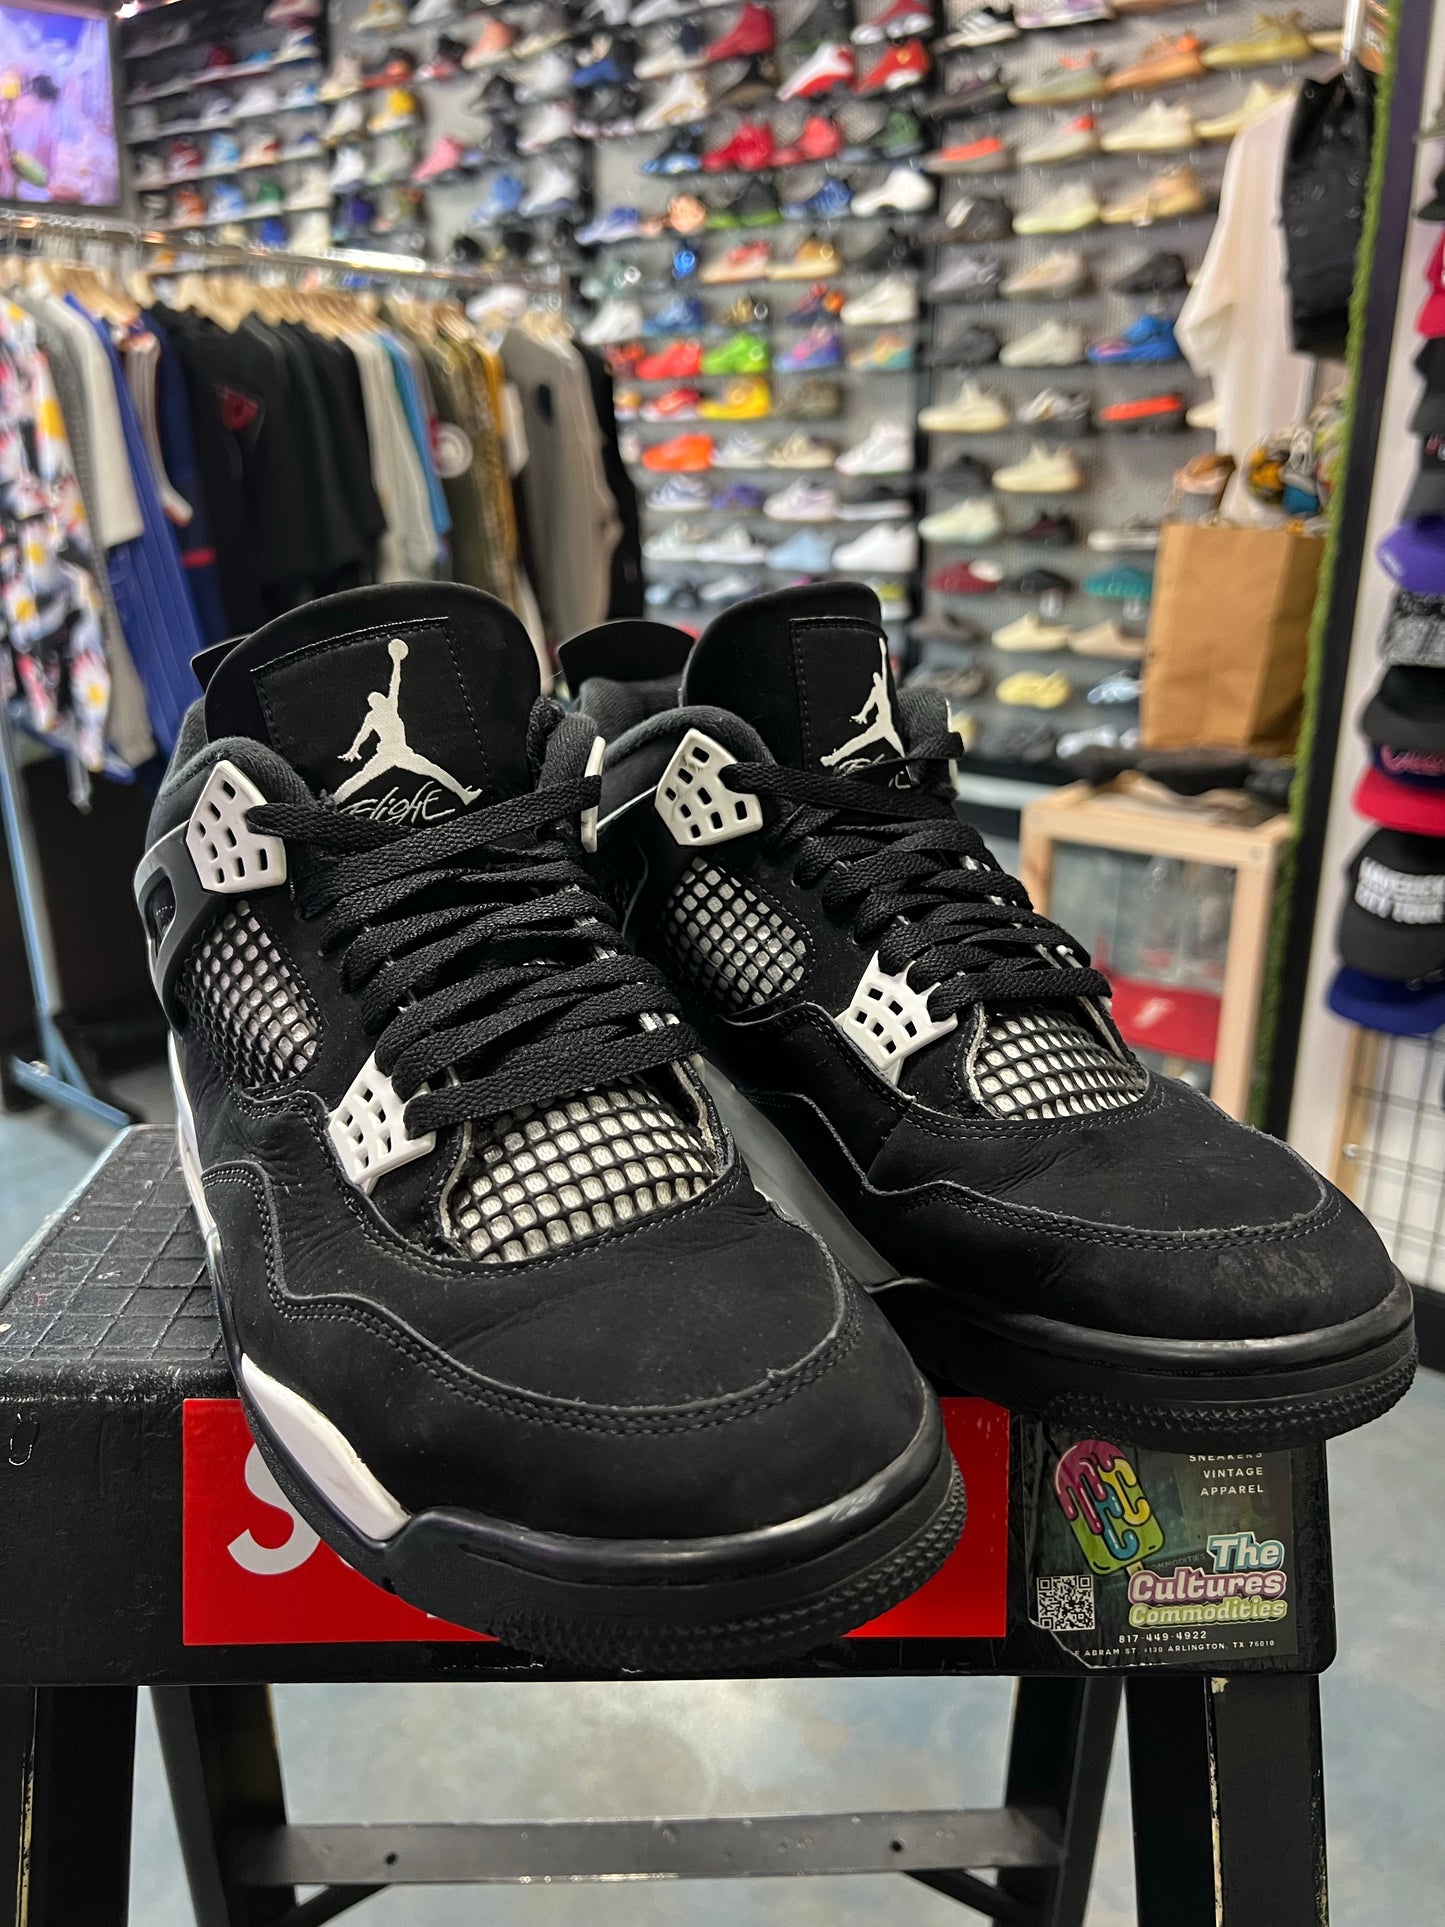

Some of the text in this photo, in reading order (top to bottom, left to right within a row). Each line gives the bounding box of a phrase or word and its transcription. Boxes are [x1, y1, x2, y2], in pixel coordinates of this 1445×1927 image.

[1203, 1466, 1264, 1479] VINTAGE
[1200, 1483, 1264, 1496] APPAREL
[1209, 1533, 1282, 1571] The
[1130, 1569, 1284, 1602] Cultures
[1130, 1597, 1286, 1626] Commodities
[1118, 1630, 1207, 1644] 817-449-4922
[1083, 1647, 1120, 1657] ABRAM
[1232, 1641, 1245, 1649] TX
